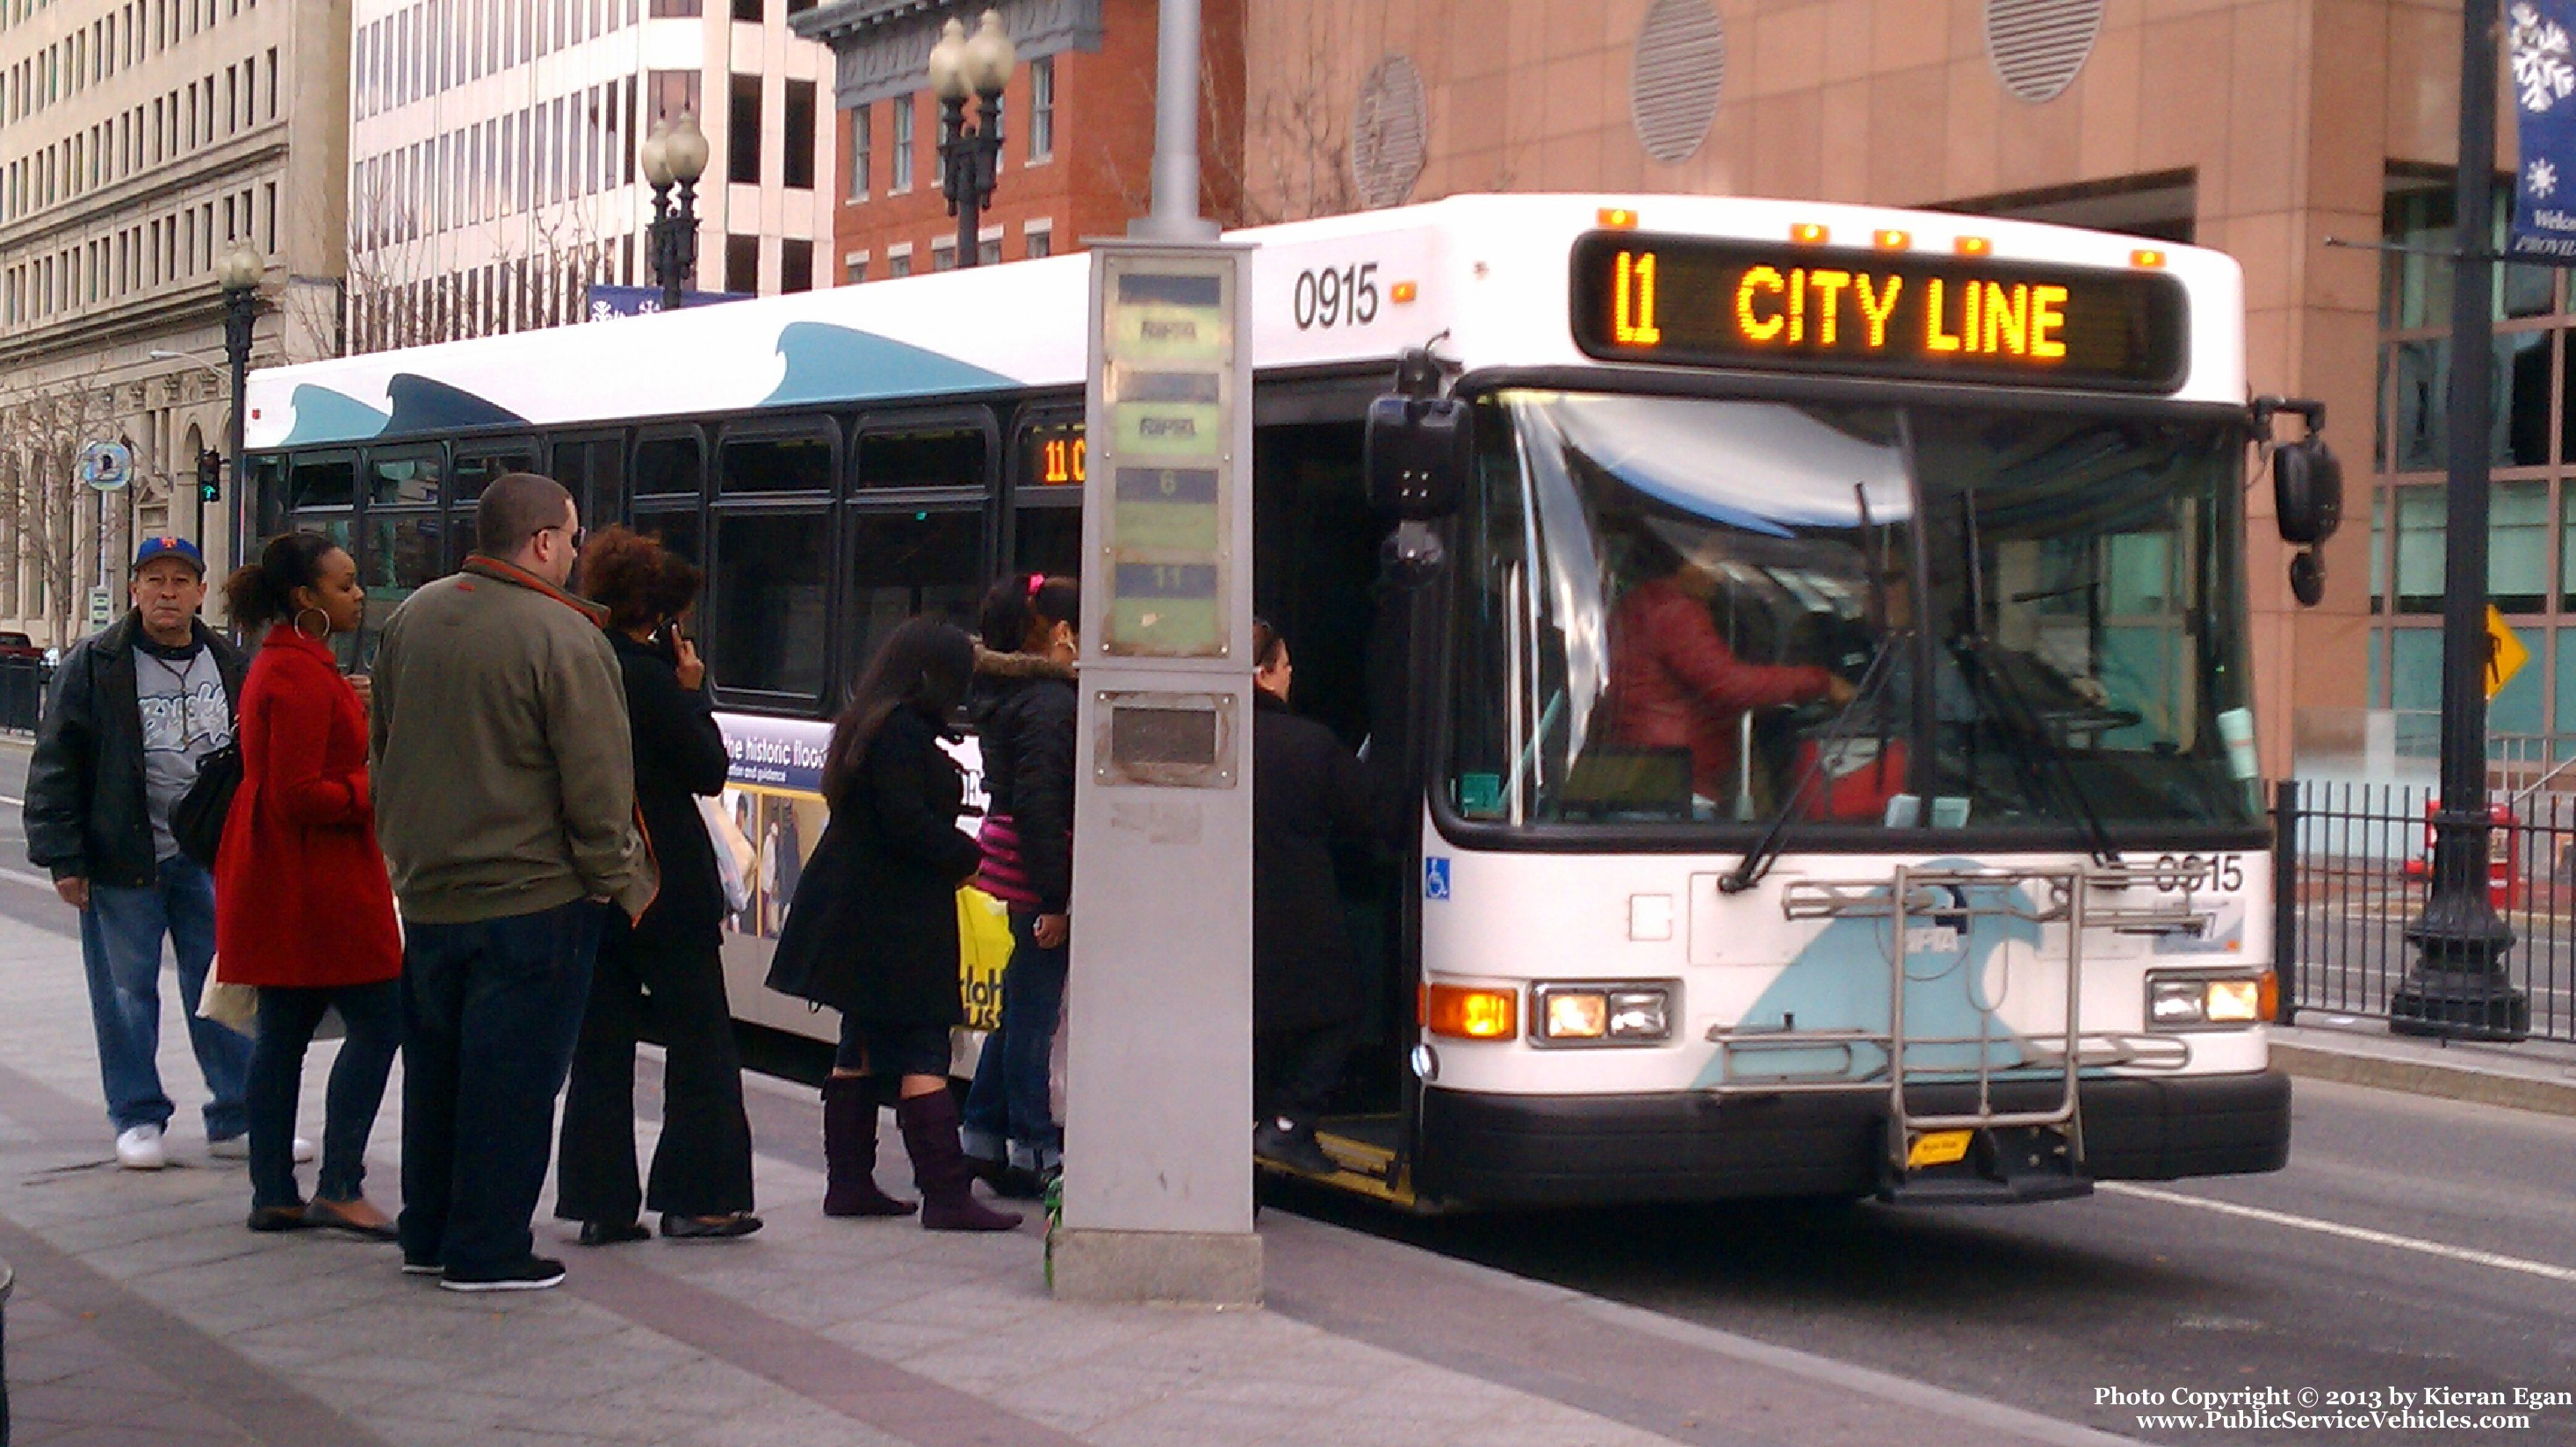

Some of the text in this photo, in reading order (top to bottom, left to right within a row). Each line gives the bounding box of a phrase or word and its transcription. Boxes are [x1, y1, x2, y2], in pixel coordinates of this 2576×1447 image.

[1295, 263, 1378, 330] 0915
[1737, 266, 1902, 347] CITY
[1927, 277, 2067, 356] LINE
[1046, 440, 1067, 481] 11
[745, 737, 790, 766] historic
